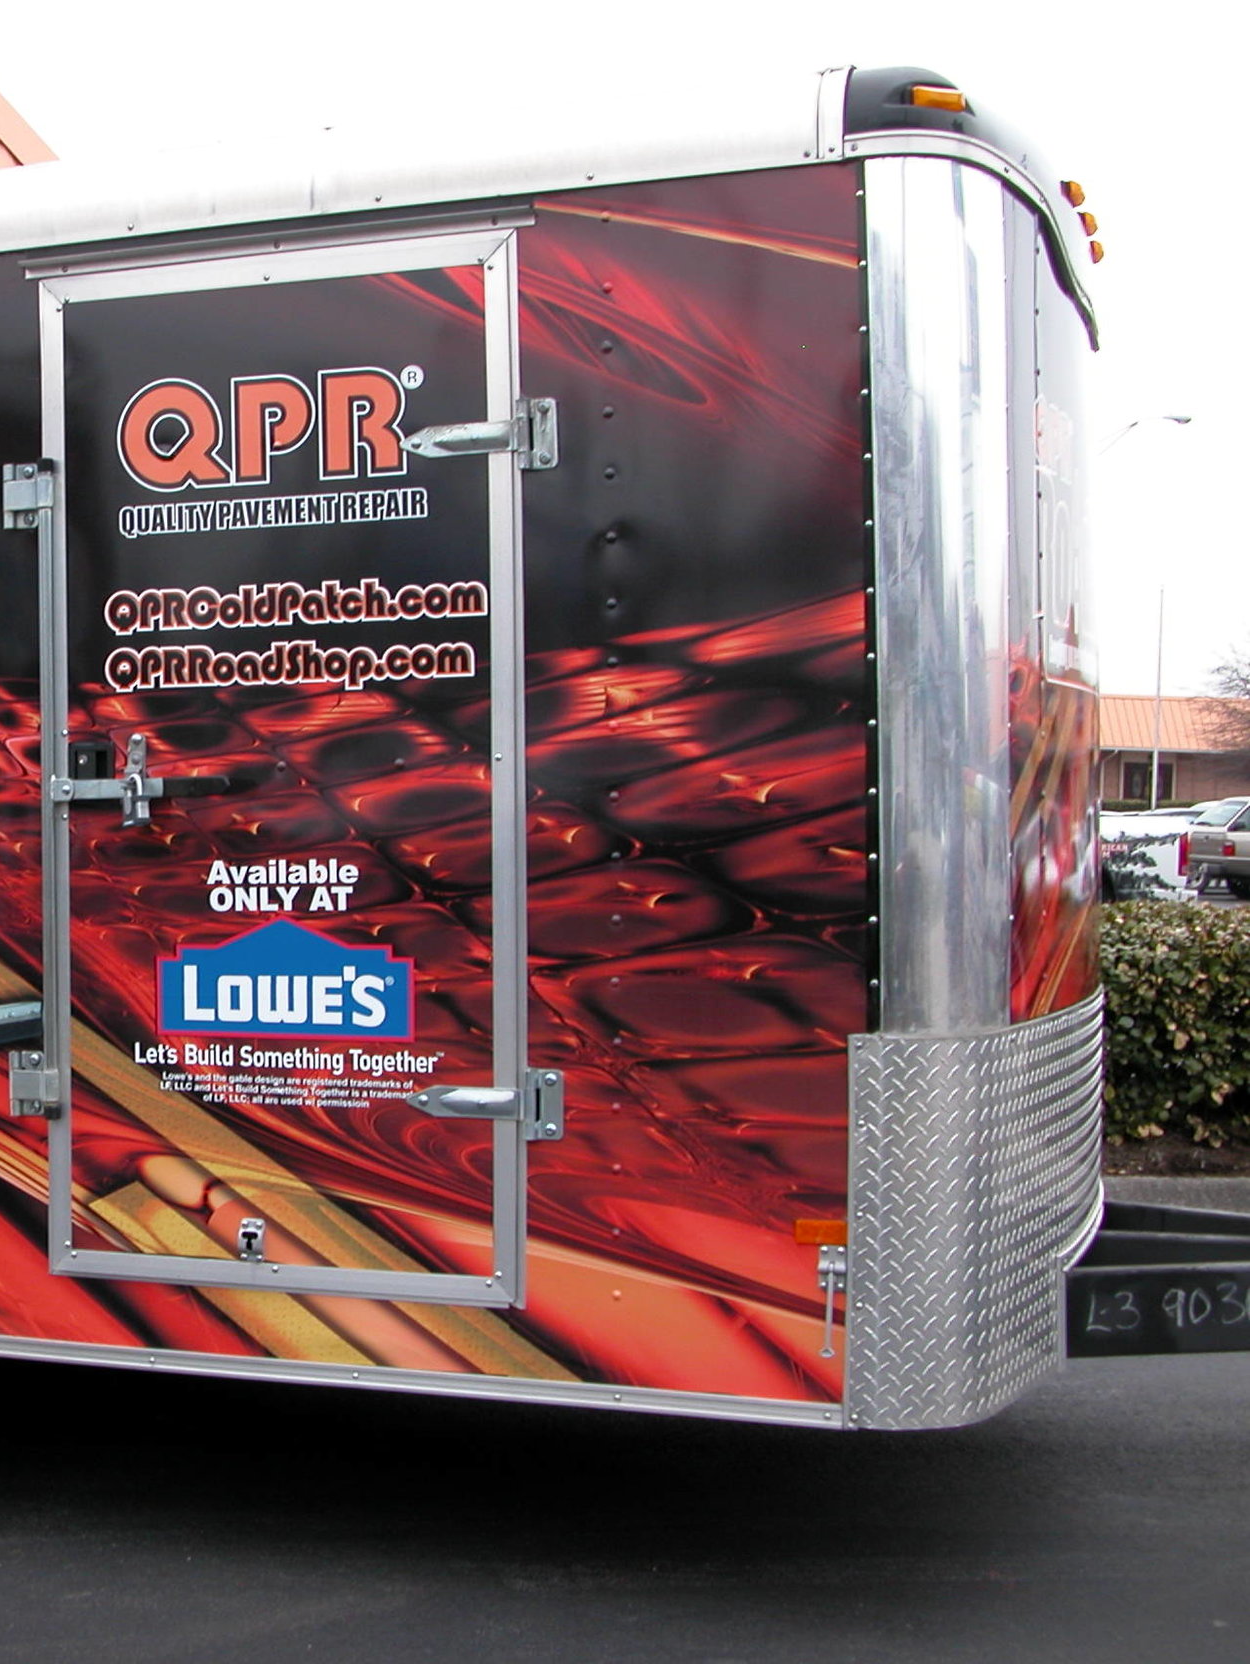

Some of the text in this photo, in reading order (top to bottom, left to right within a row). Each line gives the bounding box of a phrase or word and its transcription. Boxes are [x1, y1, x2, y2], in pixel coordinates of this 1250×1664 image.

[117, 366, 407, 492] QPR
[119, 488, 428, 538] QUALITY PAVEMENT REPAIR
[104, 578, 488, 635] QPRColdPatch.com
[104, 641, 475, 692] QPRRoadShop.com
[207, 859, 358, 885] Available
[209, 887, 353, 912] ONLY AT
[134, 1042, 438, 1076] Let's Build Something Together
[162, 1071, 192, 1081] Lowe's
[194, 1074, 211, 1082] and
[213, 1074, 227, 1082] the
[228, 1074, 253, 1084] gable
[255, 1075, 284, 1086] design
[302, 1078, 347, 1088] registered
[350, 1079, 401, 1088] trademarks
[402, 1080, 413, 1089] of
[174, 1082, 192, 1091] LLC
[194, 1083, 211, 1091] and
[213, 1083, 233, 1093] Let's
[235, 1084, 258, 1094] Build
[260, 1085, 308, 1096] Something
[311, 1087, 349, 1098] Together
[203, 1093, 213, 1102] of
[281, 1097, 302, 1106] used
[1161, 1281, 1250, 1329] 903
